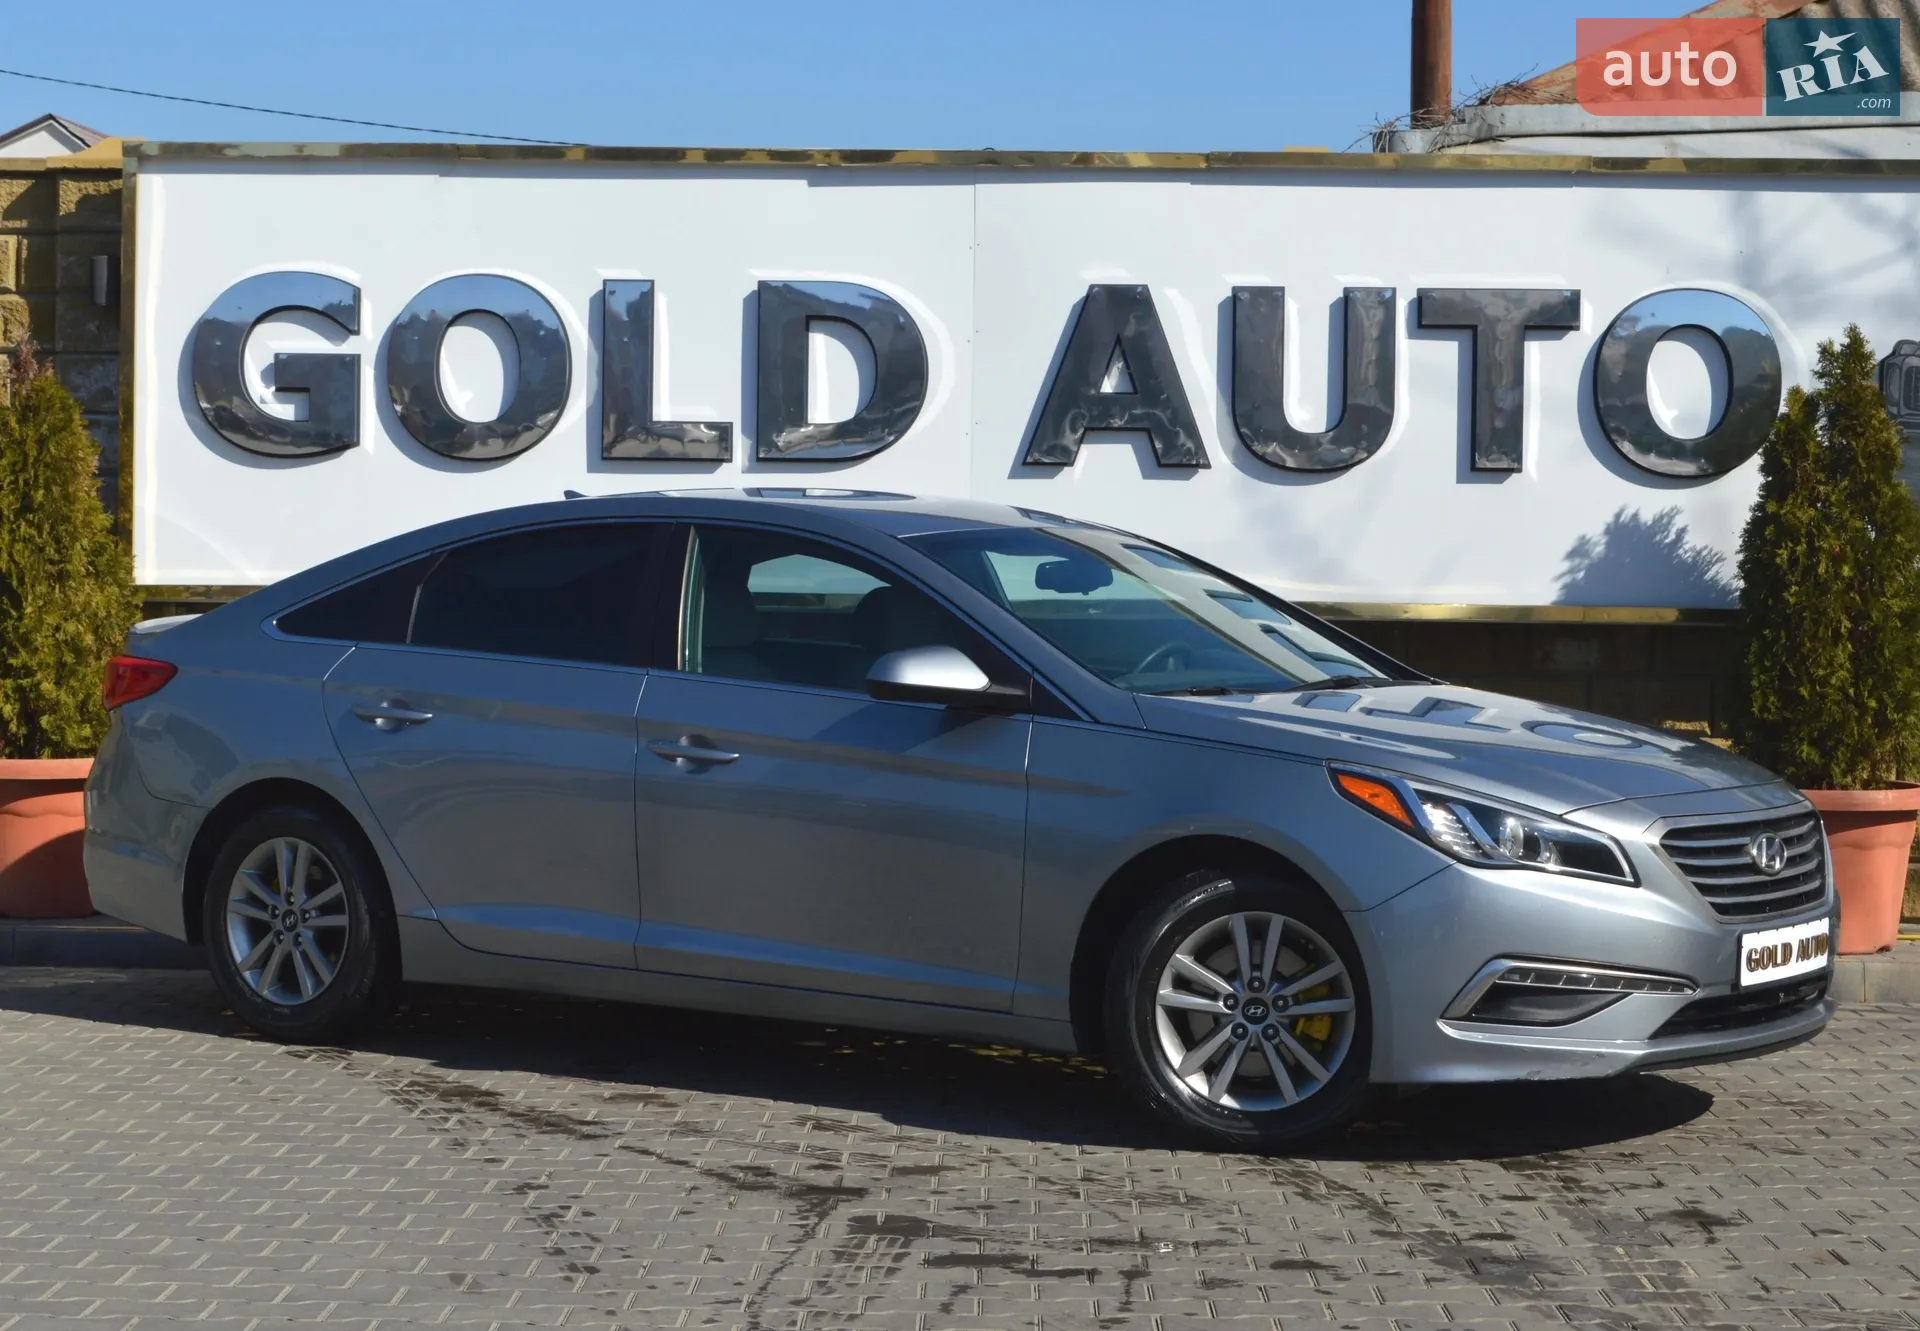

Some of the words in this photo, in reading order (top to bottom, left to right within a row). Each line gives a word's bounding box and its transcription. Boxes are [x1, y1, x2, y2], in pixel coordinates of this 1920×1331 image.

[193, 270, 929, 462] GOLD
[1022, 283, 1783, 479] AUTO
[1746, 942, 1793, 972] GOLD
[1796, 932, 1829, 963] AUTO
